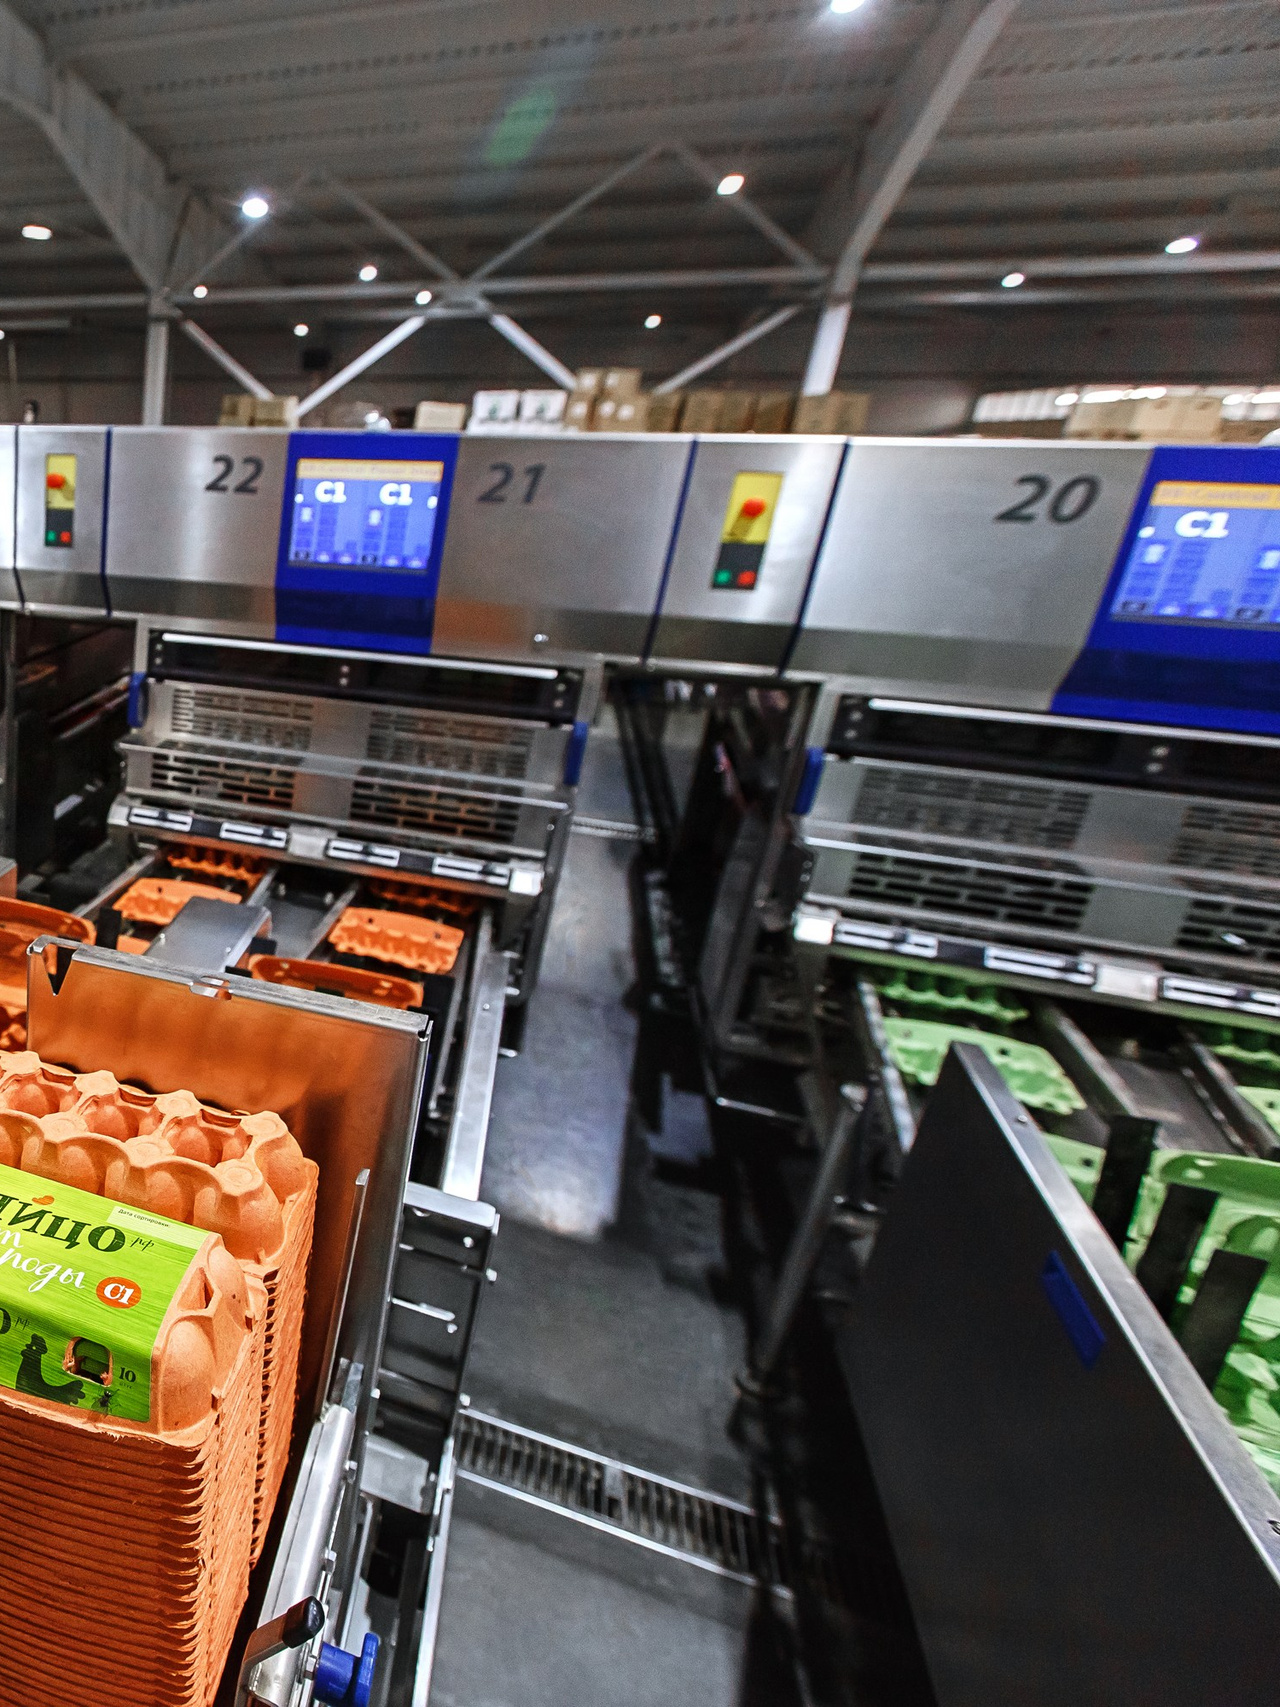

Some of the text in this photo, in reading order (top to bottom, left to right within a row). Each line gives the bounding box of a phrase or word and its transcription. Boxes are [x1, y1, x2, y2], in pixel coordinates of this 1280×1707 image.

[204, 454, 265, 495] 22
[477, 461, 547, 505] 21
[992, 473, 1102, 525] 20
[118, 1366, 137, 1383] 10
